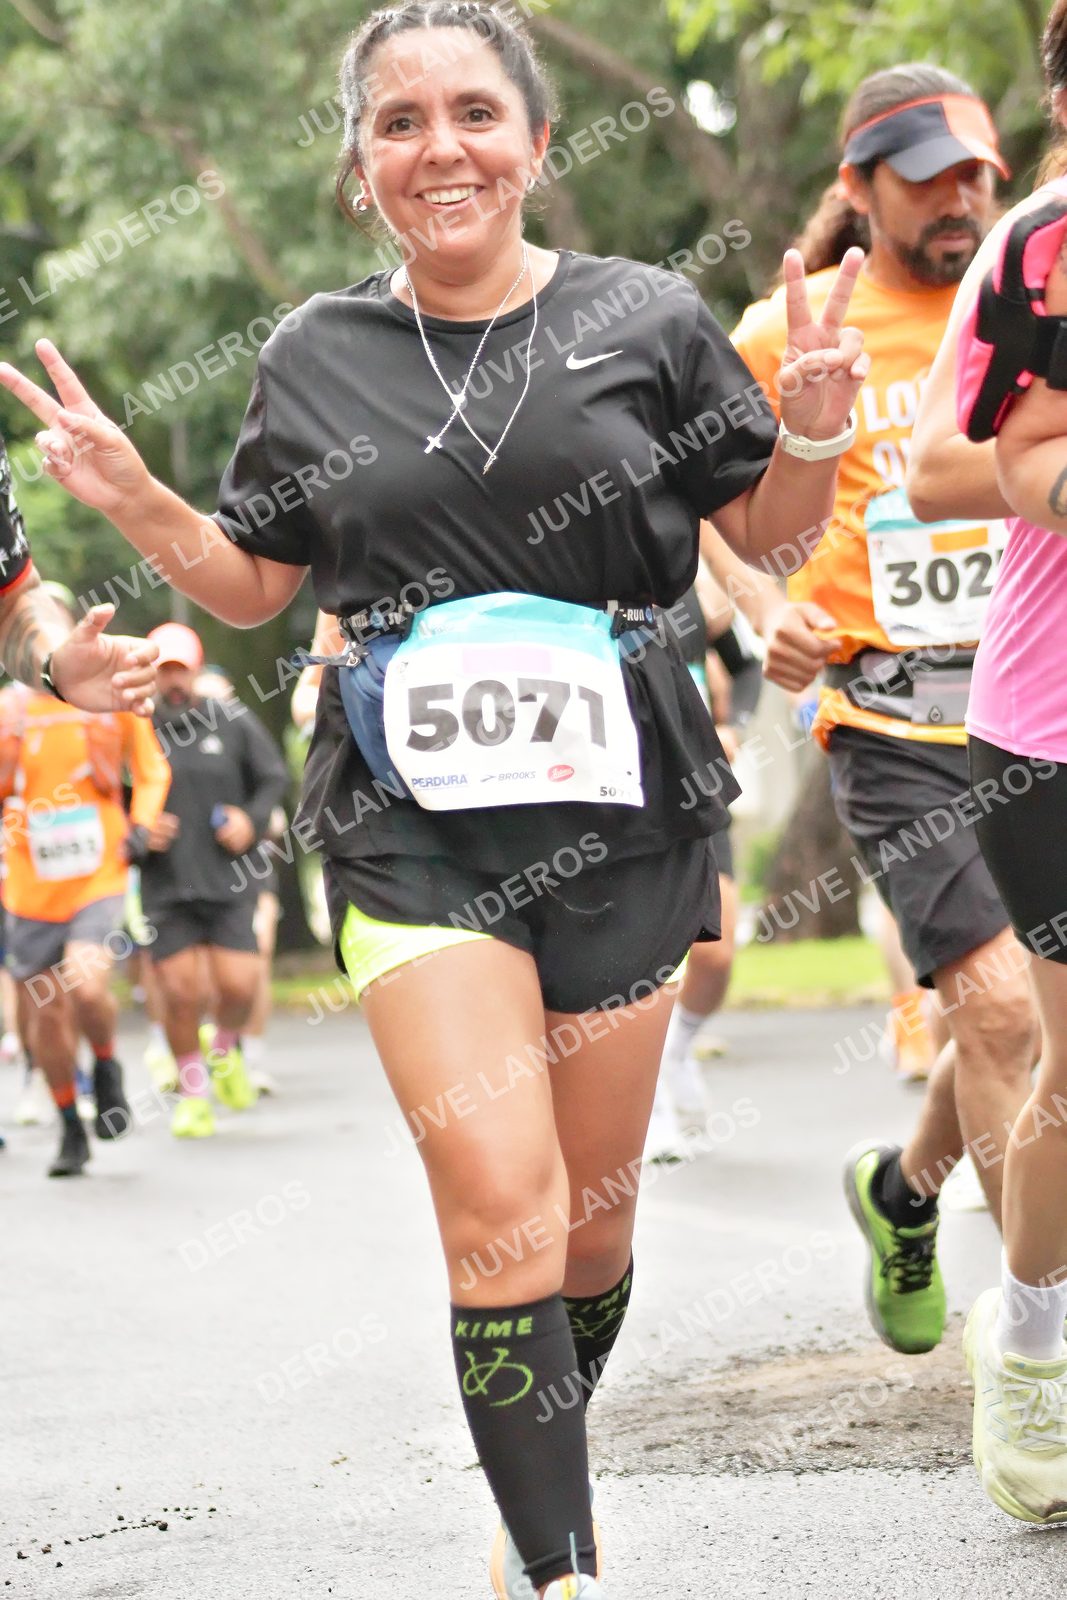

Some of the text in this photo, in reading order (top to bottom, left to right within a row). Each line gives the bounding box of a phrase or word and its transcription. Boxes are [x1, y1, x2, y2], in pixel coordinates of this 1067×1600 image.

[885, 548, 1004, 608] 302
[406, 678, 606, 752] 5071
[411, 774, 468, 787] PERDURA
[498, 771, 536, 781] BROOKS
[455, 1316, 533, 1338] KIME
